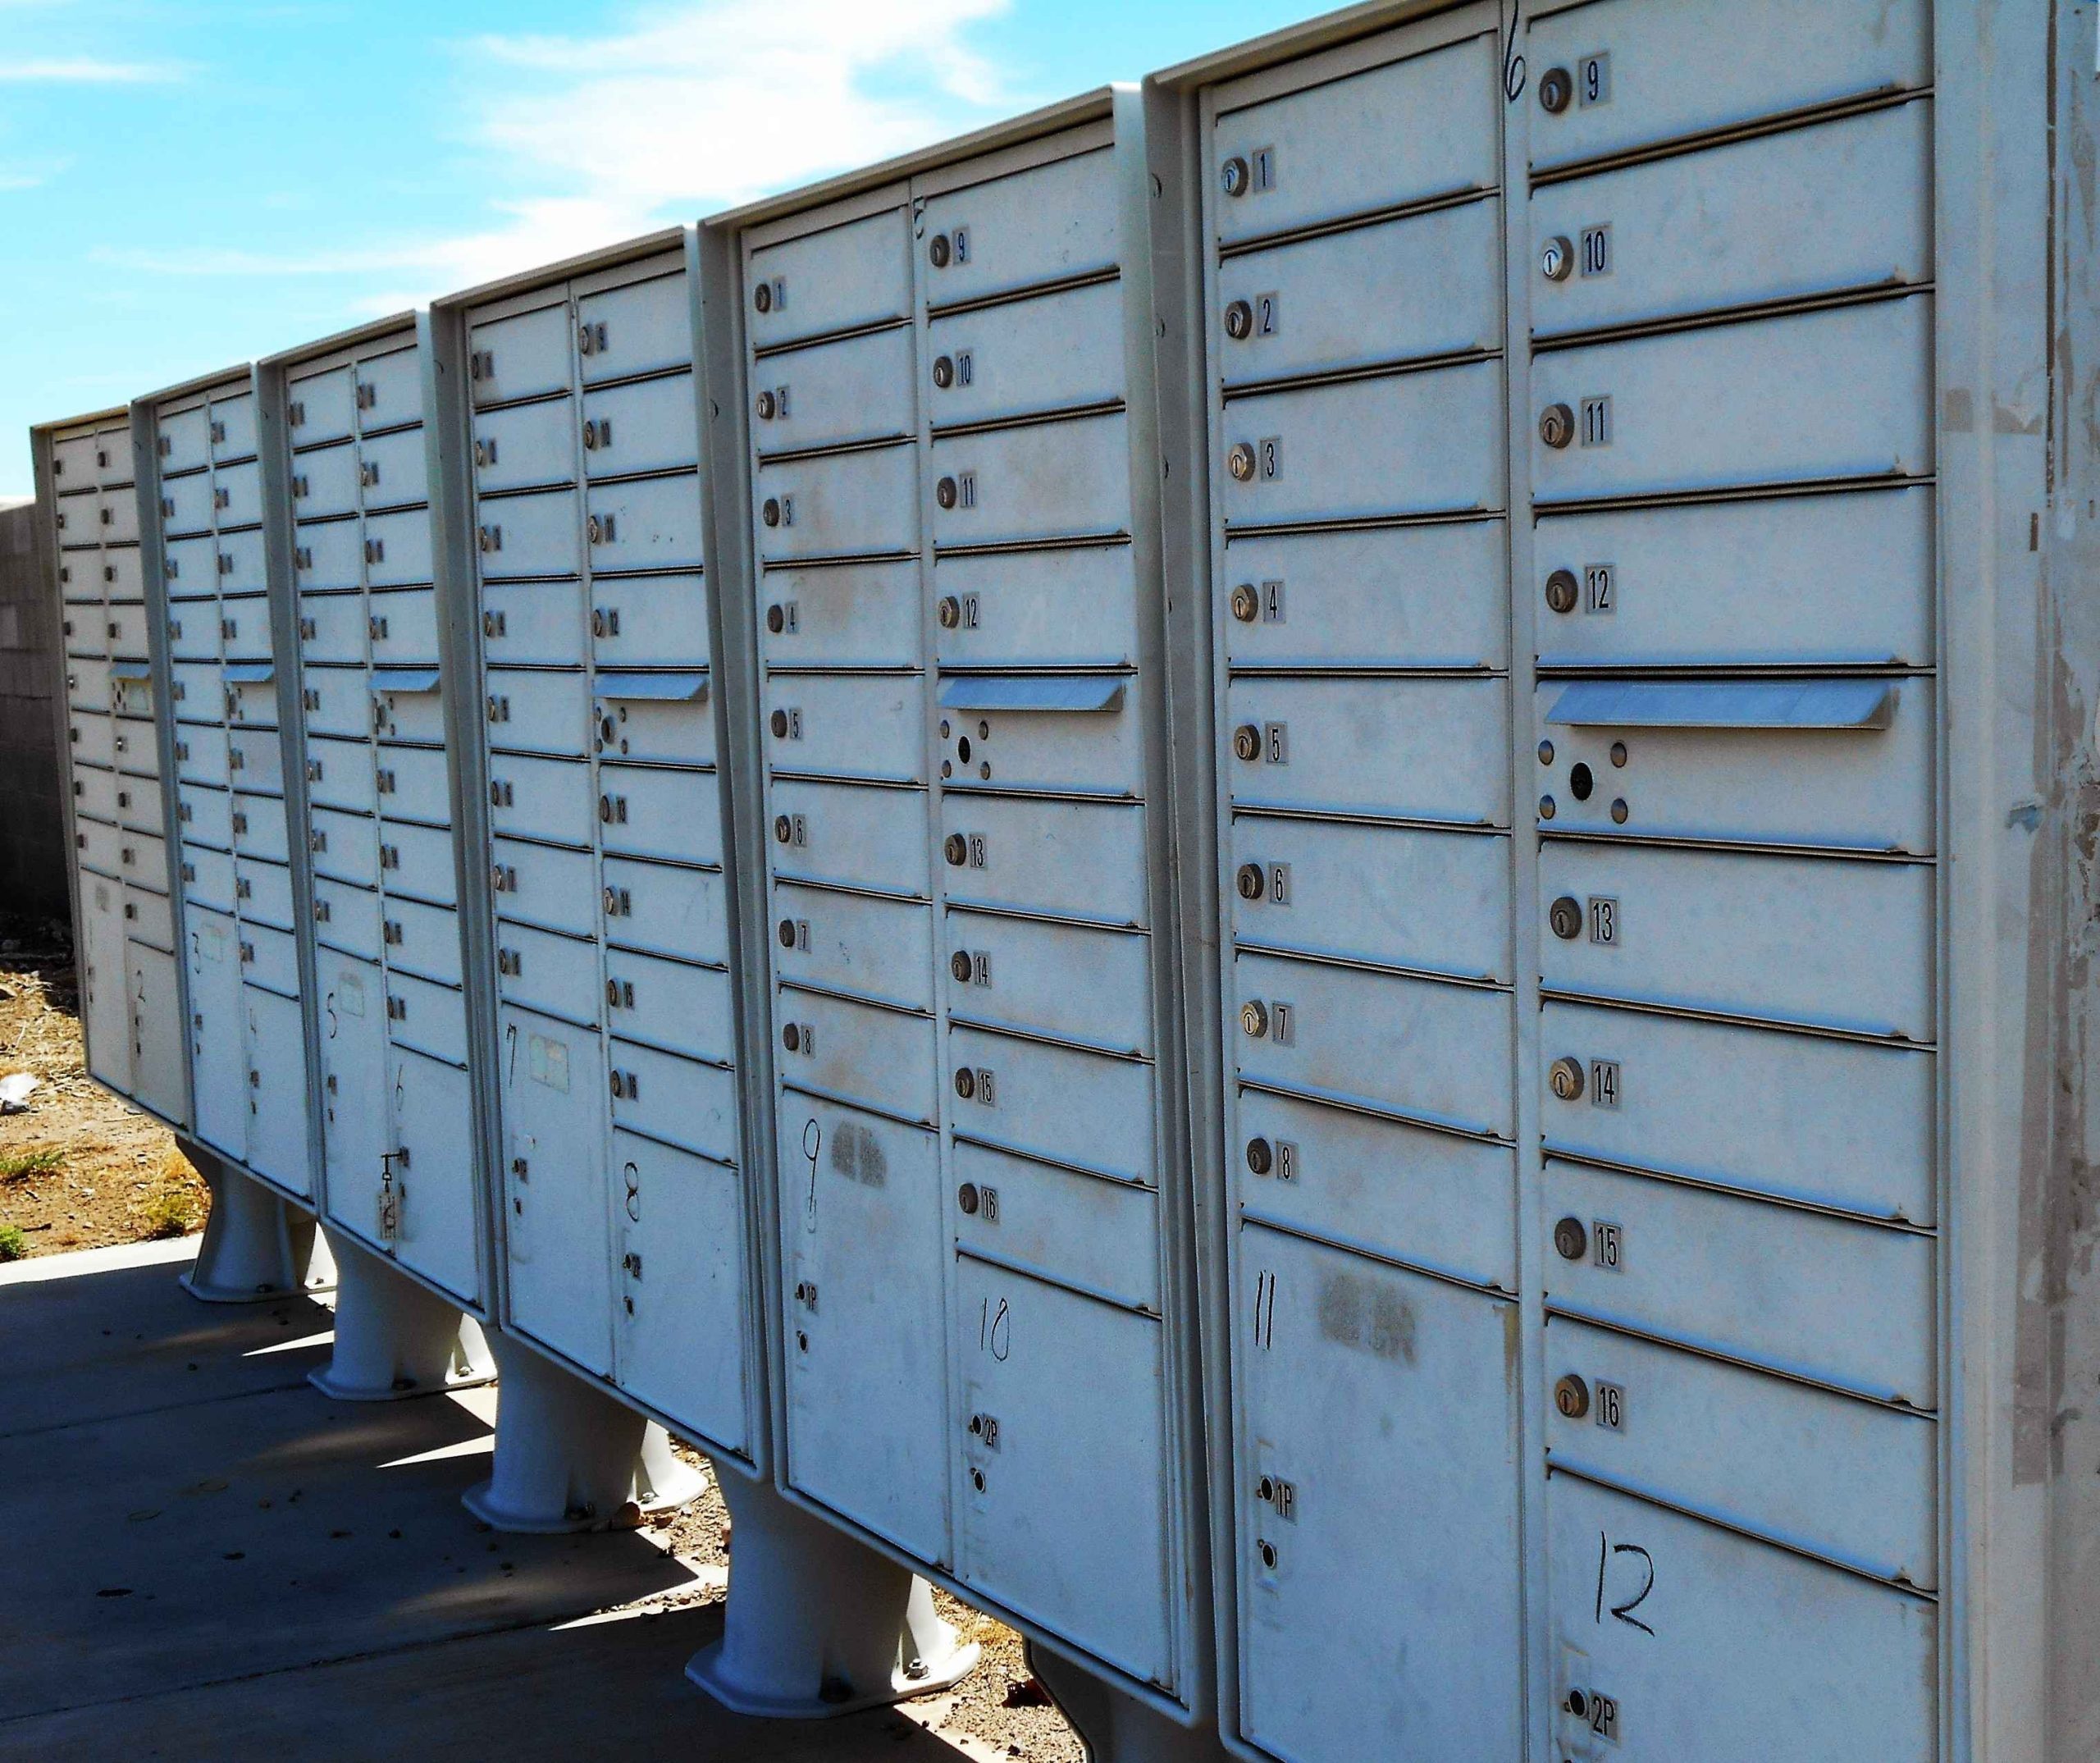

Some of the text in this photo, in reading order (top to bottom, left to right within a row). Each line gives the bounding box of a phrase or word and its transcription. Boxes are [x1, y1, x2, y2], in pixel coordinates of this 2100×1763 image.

[1504, 0, 1526, 103] 6
[1588, 61, 1598, 100] 9
[959, 233, 965, 262] 9
[1586, 231, 1605, 272] 10
[1263, 299, 1271, 333] 2
[960, 355, 970, 383] 10
[1586, 401, 1604, 441] 11
[1267, 443, 1274, 477] 3
[964, 477, 974, 505] 11
[786, 500, 791, 524] 3
[1269, 586, 1276, 619] 4
[1589, 569, 1609, 610] 12
[966, 596, 976, 626] 12
[793, 714, 798, 738] 5
[1272, 728, 1279, 761] 5
[797, 819, 802, 844] 6
[973, 838, 983, 866] 13
[1276, 868, 1283, 902] 6
[801, 925, 806, 949] 7
[1594, 902, 1613, 941] 13
[976, 957, 987, 984] 14
[1279, 1008, 1285, 1040] 7
[506, 1022, 516, 1088] 7
[806, 1030, 810, 1053] 8
[981, 1072, 992, 1103] 15
[1596, 1065, 1614, 1103] 14
[803, 1118, 820, 1212] 9
[1283, 1147, 1290, 1179] 8
[624, 1162, 640, 1222] 8
[984, 1190, 995, 1219] 16
[1598, 1226, 1616, 1266] 15
[981, 1297, 1010, 1362] 10
[1600, 1388, 1618, 1427] 16
[985, 1418, 997, 1448] 2P
[1277, 1483, 1292, 1517] 1P
[1596, 1531, 1655, 1636] 12
[1593, 1696, 1614, 1734] 2P
